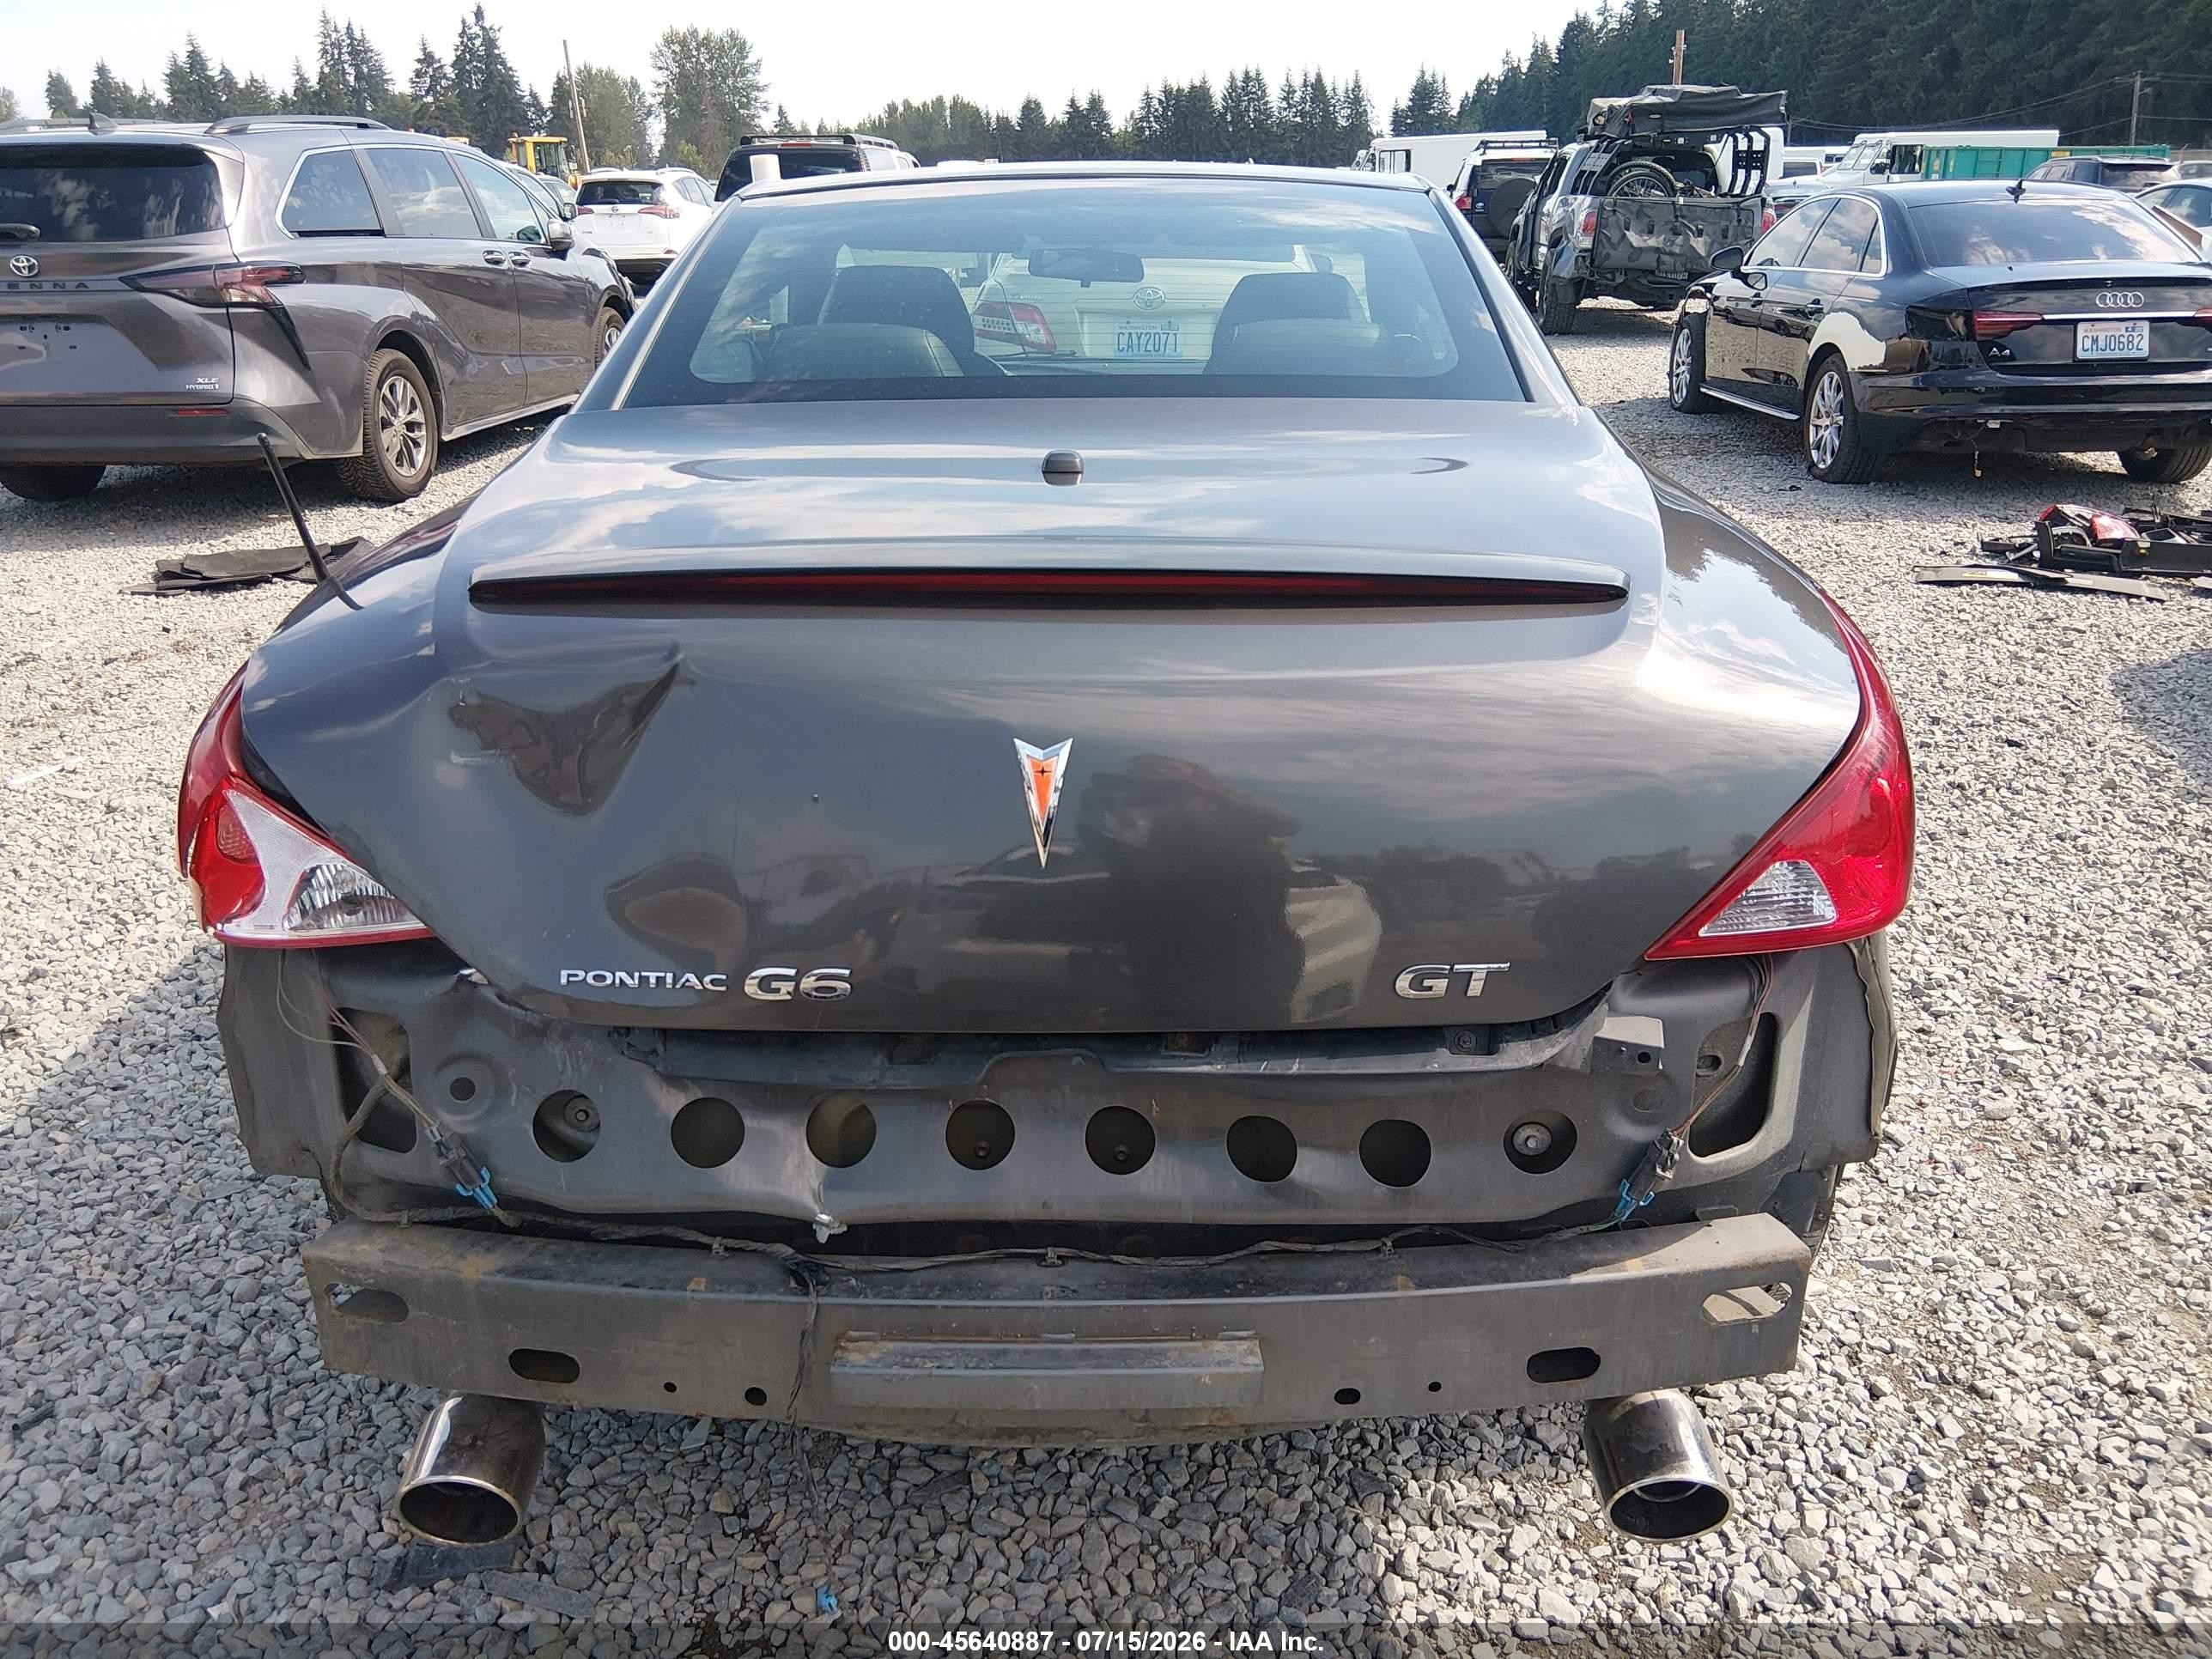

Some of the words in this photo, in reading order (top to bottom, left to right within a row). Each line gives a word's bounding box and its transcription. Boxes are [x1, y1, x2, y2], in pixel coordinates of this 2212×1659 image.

[1117, 331, 1178, 352] CAY2071
[1988, 347, 2010, 357] A4
[2081, 333, 2144, 352] CMJ0682
[560, 969, 728, 991] PONTIAC
[744, 967, 852, 1000] G6
[1395, 962, 1511, 999] GT
